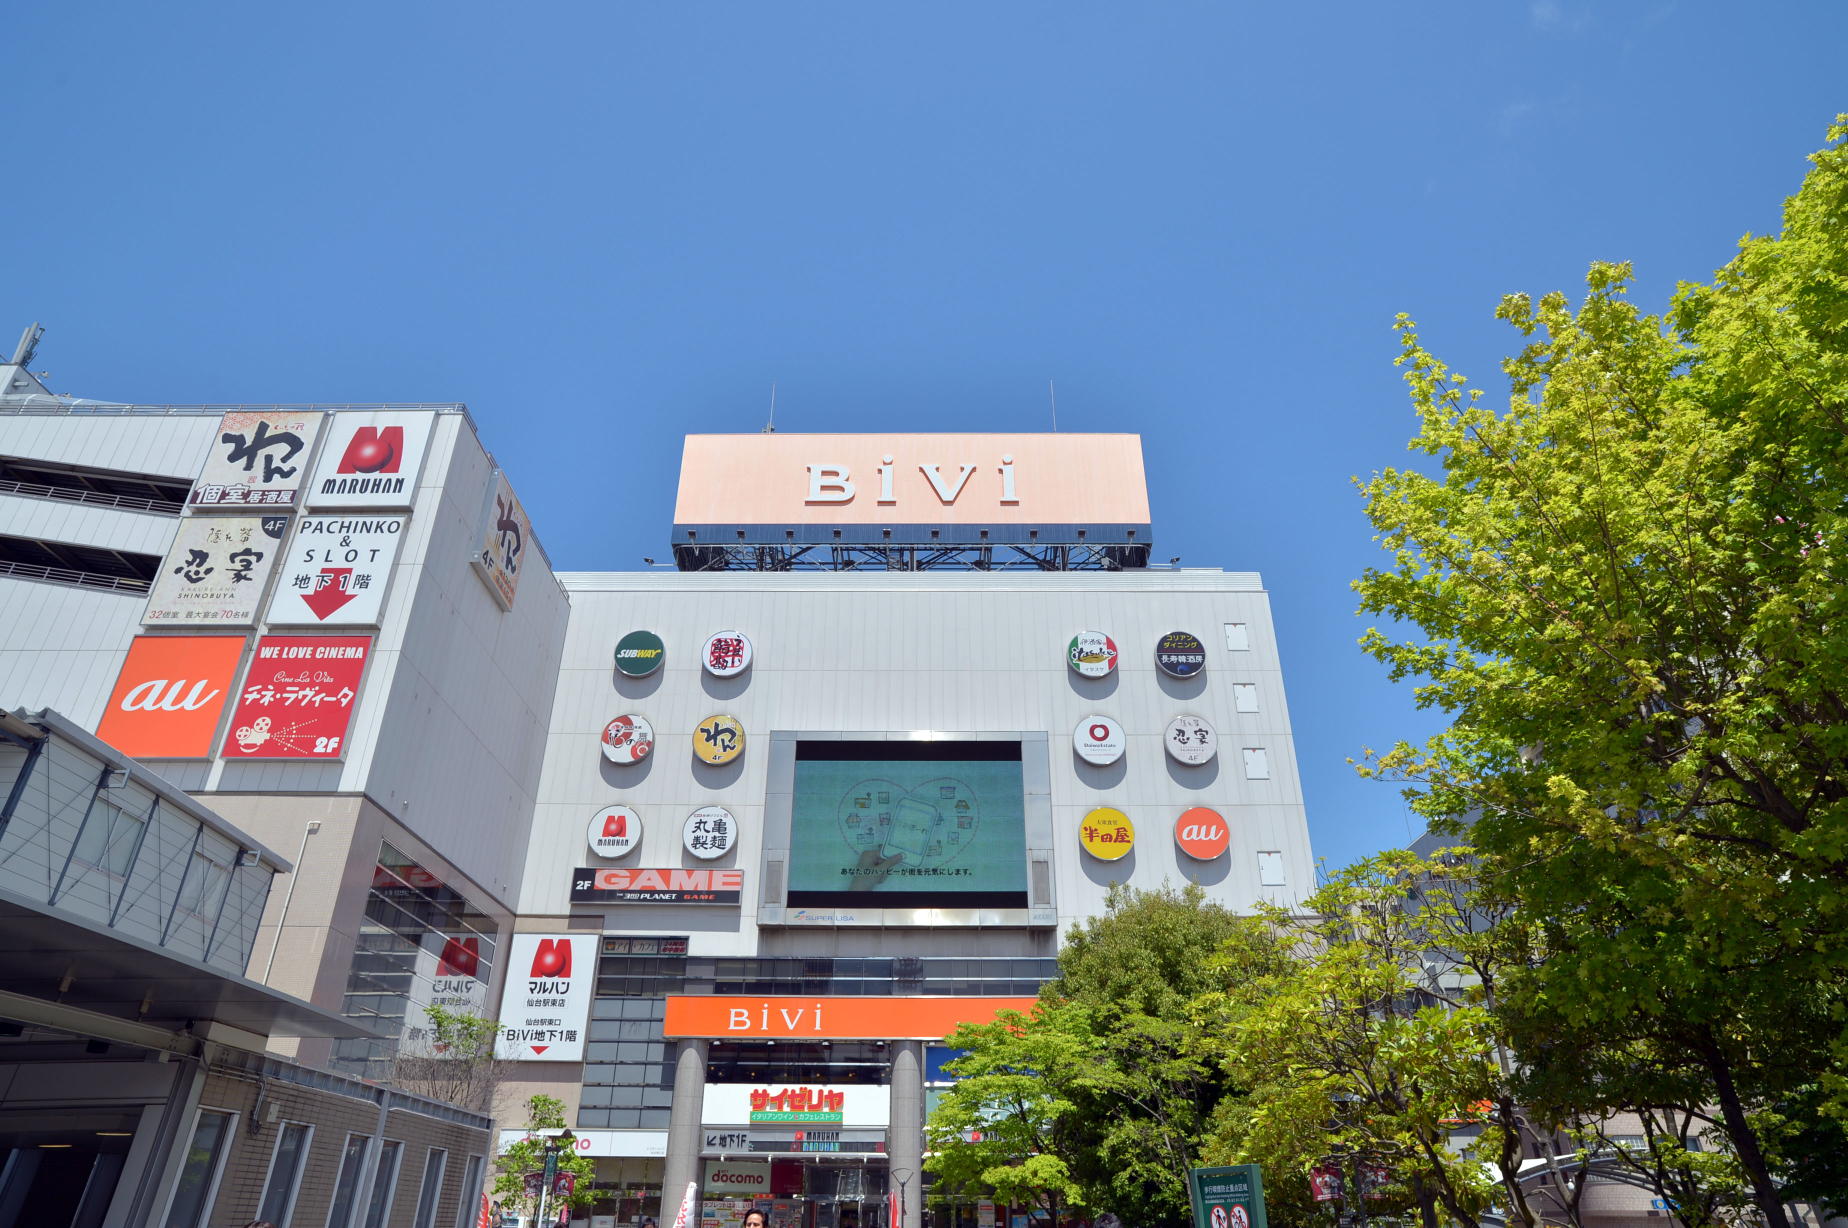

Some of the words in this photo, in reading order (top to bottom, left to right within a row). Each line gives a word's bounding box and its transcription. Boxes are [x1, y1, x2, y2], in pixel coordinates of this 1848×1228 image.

[221, 420, 305, 483] わん
[320, 477, 405, 494] MARUHAN
[804, 453, 1020, 507] BiVi
[263, 519, 286, 531] 4F
[299, 520, 401, 534] PACHINKO
[339, 535, 352, 547] &
[174, 547, 264, 584] 忍家
[482, 549, 494, 570] 4F
[292, 573, 372, 590] 地下1階
[260, 646, 281, 659] WE
[282, 646, 313, 659] LOVE
[315, 646, 363, 659] CINEMA
[617, 649, 661, 658] SUBWAY
[273, 671, 295, 683] Cine
[296, 672, 310, 682] La
[313, 671, 334, 683] Vita
[120, 679, 220, 712] au
[243, 685, 354, 707] チネ・ラヴィータ
[700, 721, 737, 752] わん
[313, 737, 340, 753] 2F
[1083, 825, 1131, 843] 半田屋
[1182, 824, 1225, 840] au
[597, 839, 629, 847] MARUHAN
[575, 881, 592, 890] 2F
[594, 869, 742, 891] GAME
[528, 981, 570, 994] マルハン
[527, 998, 566, 1007] 仙台駅東店
[525, 1018, 562, 1026] 仙台駅東口
[727, 1003, 822, 1031] BiVi
[506, 1029, 578, 1042] BiVi地下1階
[750, 1087, 844, 1112] サイゼリヤ
[719, 1133, 747, 1148] 地下1F
[806, 1131, 840, 1141] MARUHAN
[712, 1169, 764, 1184] docomo
